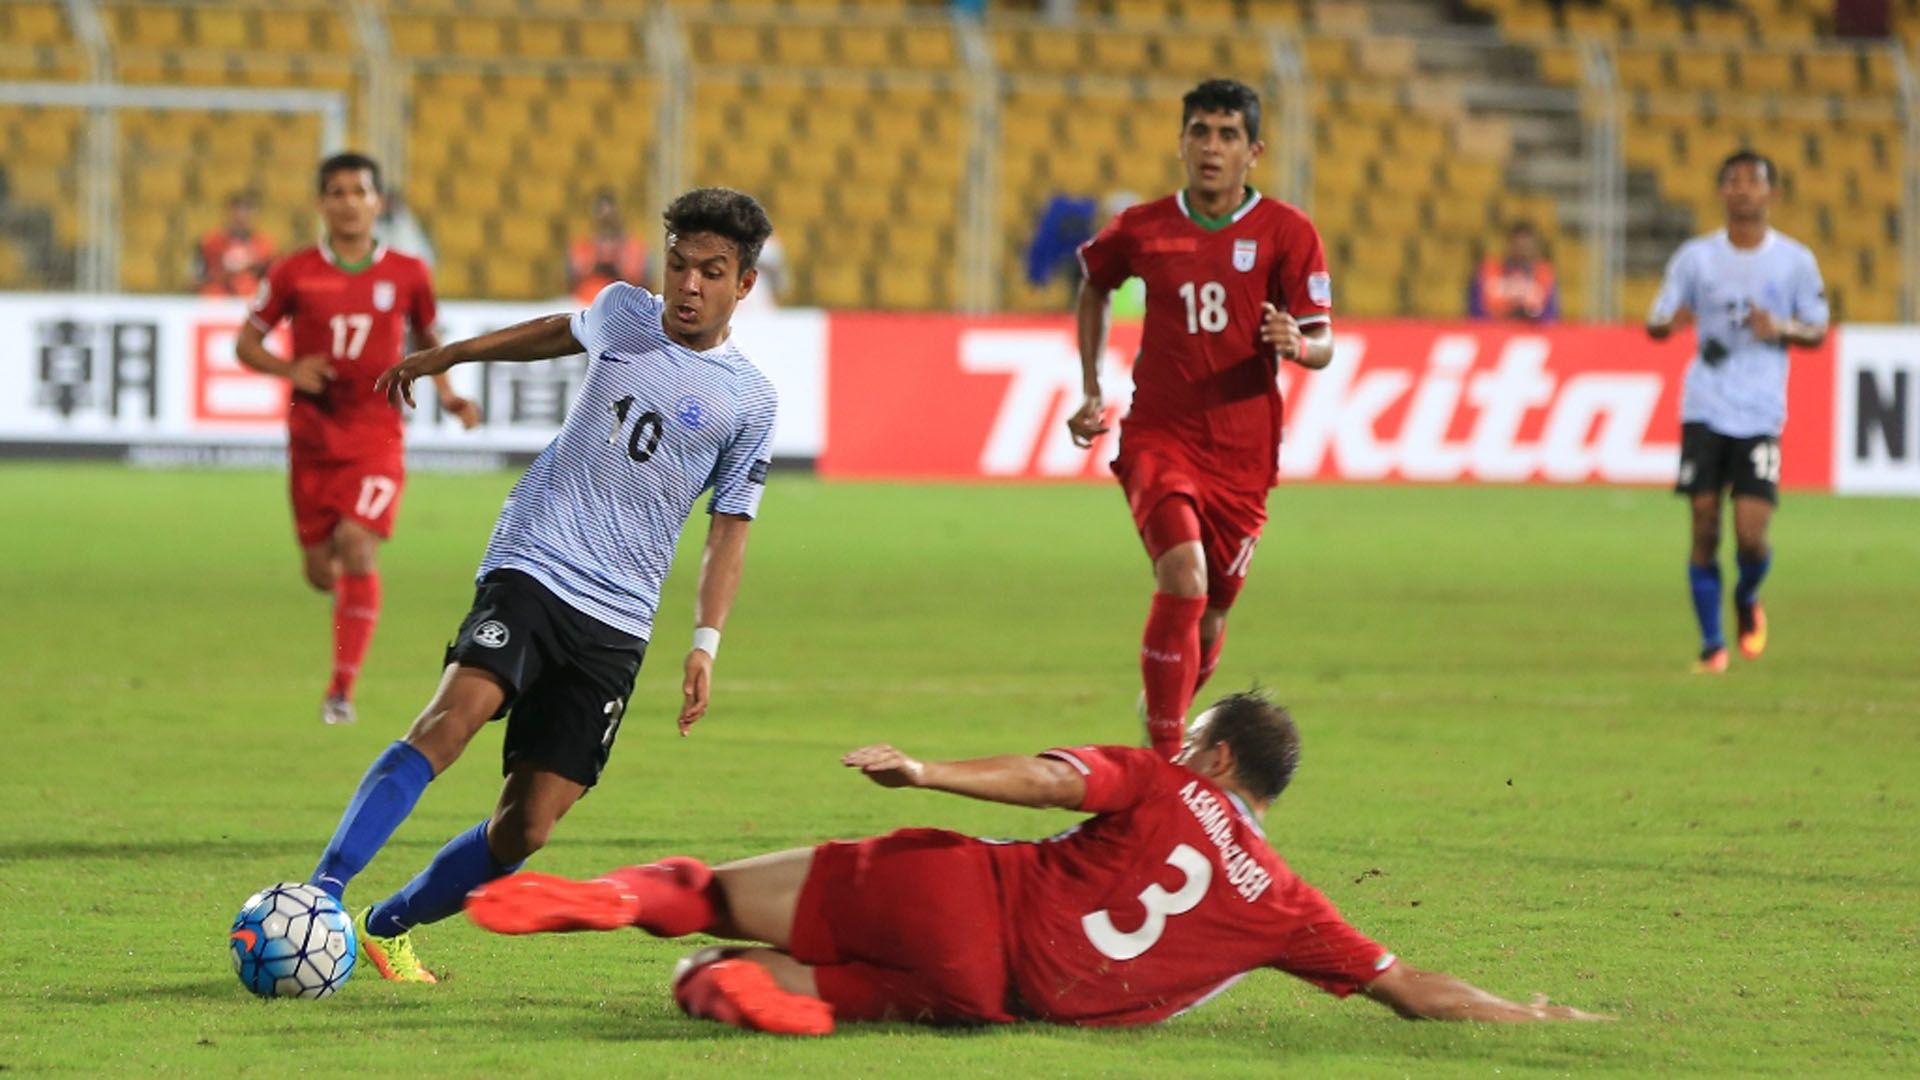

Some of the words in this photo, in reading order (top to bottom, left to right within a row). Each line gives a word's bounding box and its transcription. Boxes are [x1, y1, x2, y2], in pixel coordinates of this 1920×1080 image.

[330, 313, 373, 359] 17
[1179, 281, 1228, 334] 18
[607, 393, 664, 463] 10
[957, 326, 1681, 484] Mkita
[355, 475, 397, 520] 17
[1081, 843, 1213, 961] 3
